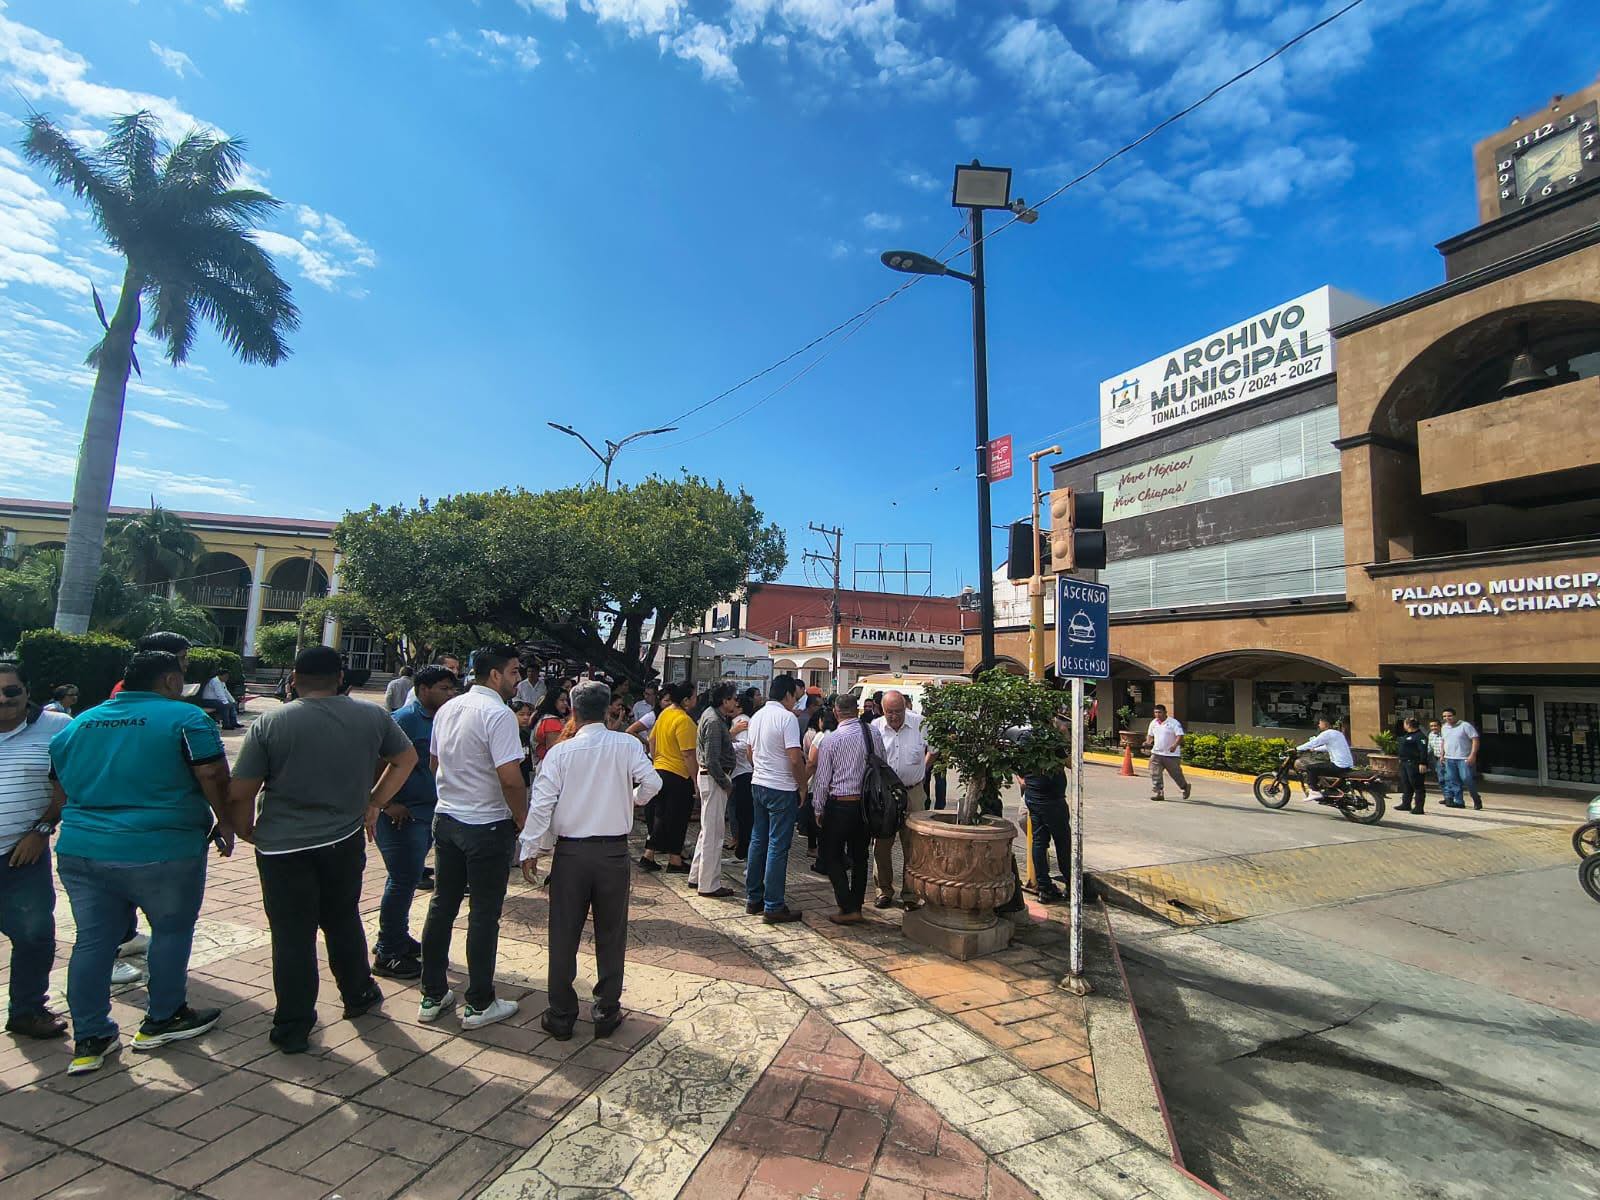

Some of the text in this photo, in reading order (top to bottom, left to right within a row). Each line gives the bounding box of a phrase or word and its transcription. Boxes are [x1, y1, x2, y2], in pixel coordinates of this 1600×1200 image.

[1568, 114, 1577, 124] 1
[1582, 121, 1592, 132] 2
[1533, 123, 1554, 141] 12
[1515, 135, 1530, 148] 11
[1583, 134, 1594, 148] 3
[1498, 159, 1512, 172] 10
[1499, 173, 1509, 186] 9
[1501, 189, 1509, 199] 8
[1541, 182, 1553, 196] 6
[1519, 194, 1527, 205] 7
[1163, 305, 1305, 382] ARCHIVO
[1151, 330, 1324, 412] MUNICIPAL
[1191, 387, 1236, 413] CHIAPAS
[1248, 372, 1278, 393] 2024
[1288, 357, 1322, 380] 2027
[1137, 480, 1188, 502] Chiapas!
[1392, 572, 1600, 601] PALACIO MUNICIP
[1063, 585, 1106, 604] ASCENSO
[1405, 592, 1600, 617] TONALÁ, CHIAPA
[852, 628, 965, 646] FARMACIA LA ESP
[1062, 656, 1106, 672] DESCENSO
[79, 717, 147, 729] PETRONAS
